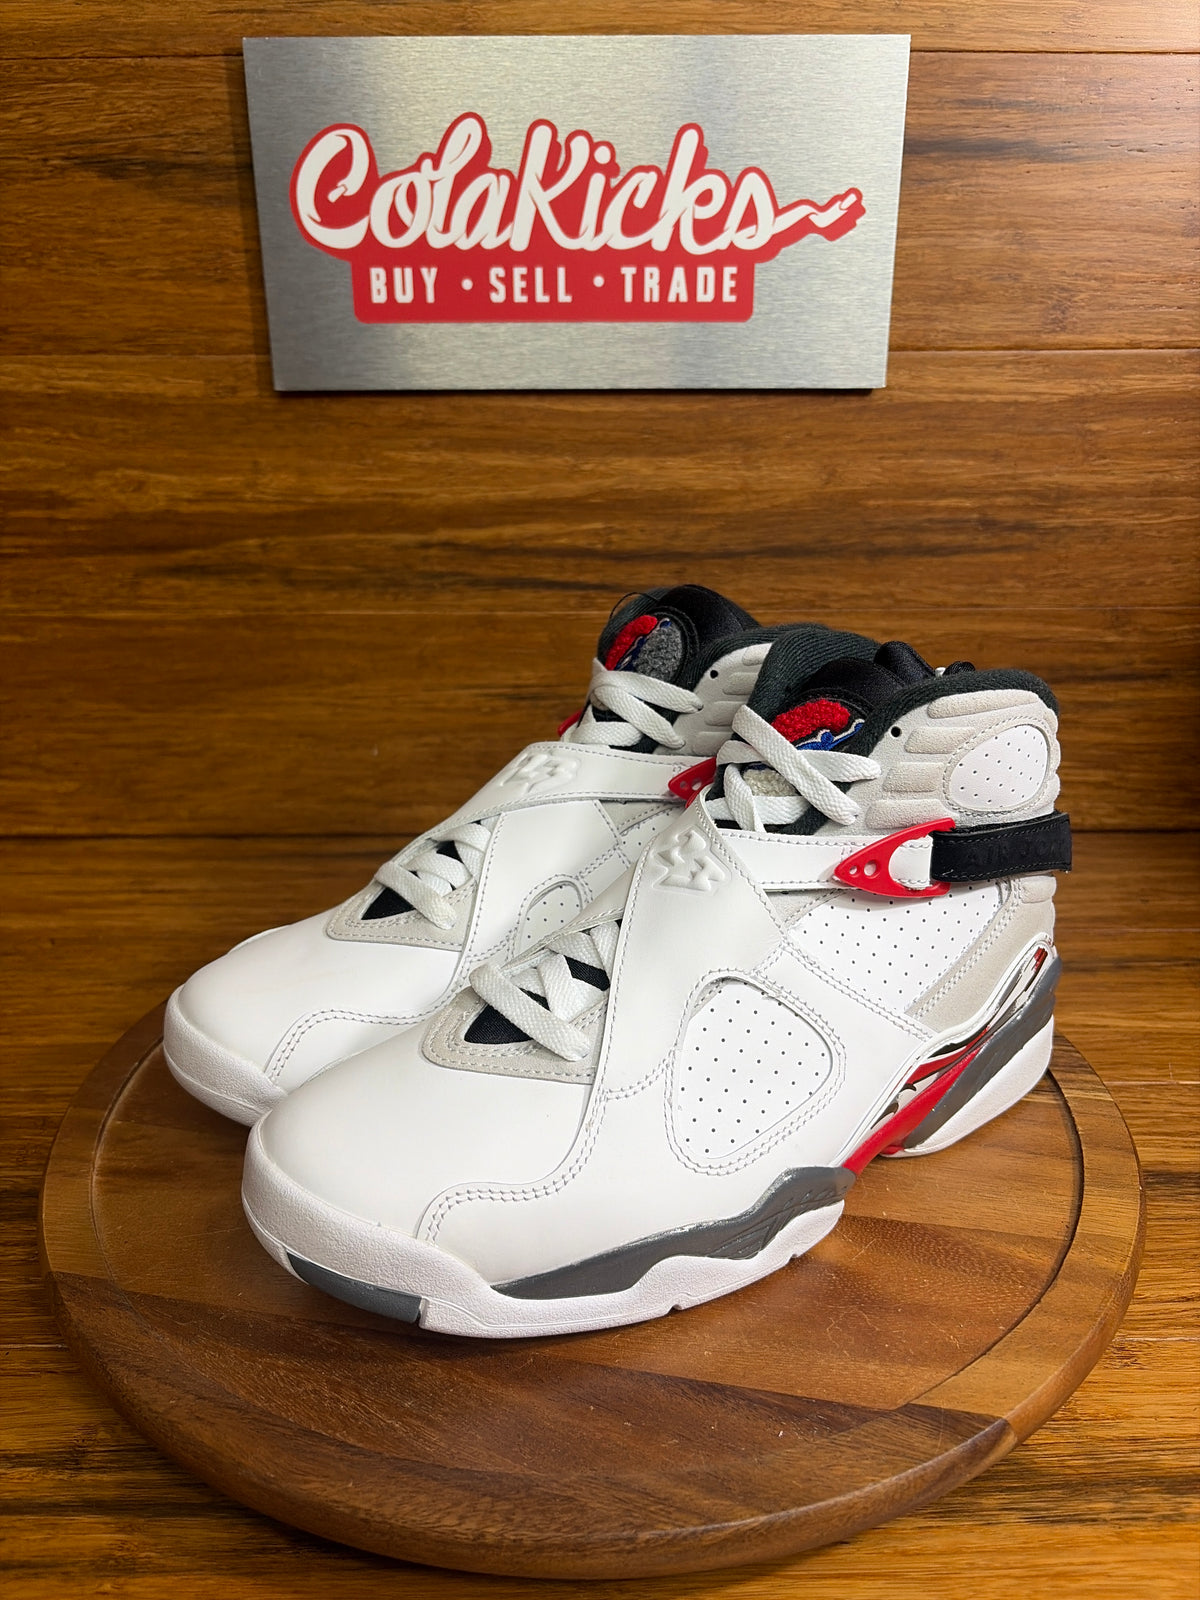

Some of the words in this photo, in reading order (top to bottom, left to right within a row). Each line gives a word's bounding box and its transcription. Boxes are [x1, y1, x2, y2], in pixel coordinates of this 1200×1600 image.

[295, 116, 860, 256] ColaKicks
[370, 266, 438, 304] BUY
[489, 266, 572, 303] SELL
[620, 265, 738, 303] TRADE
